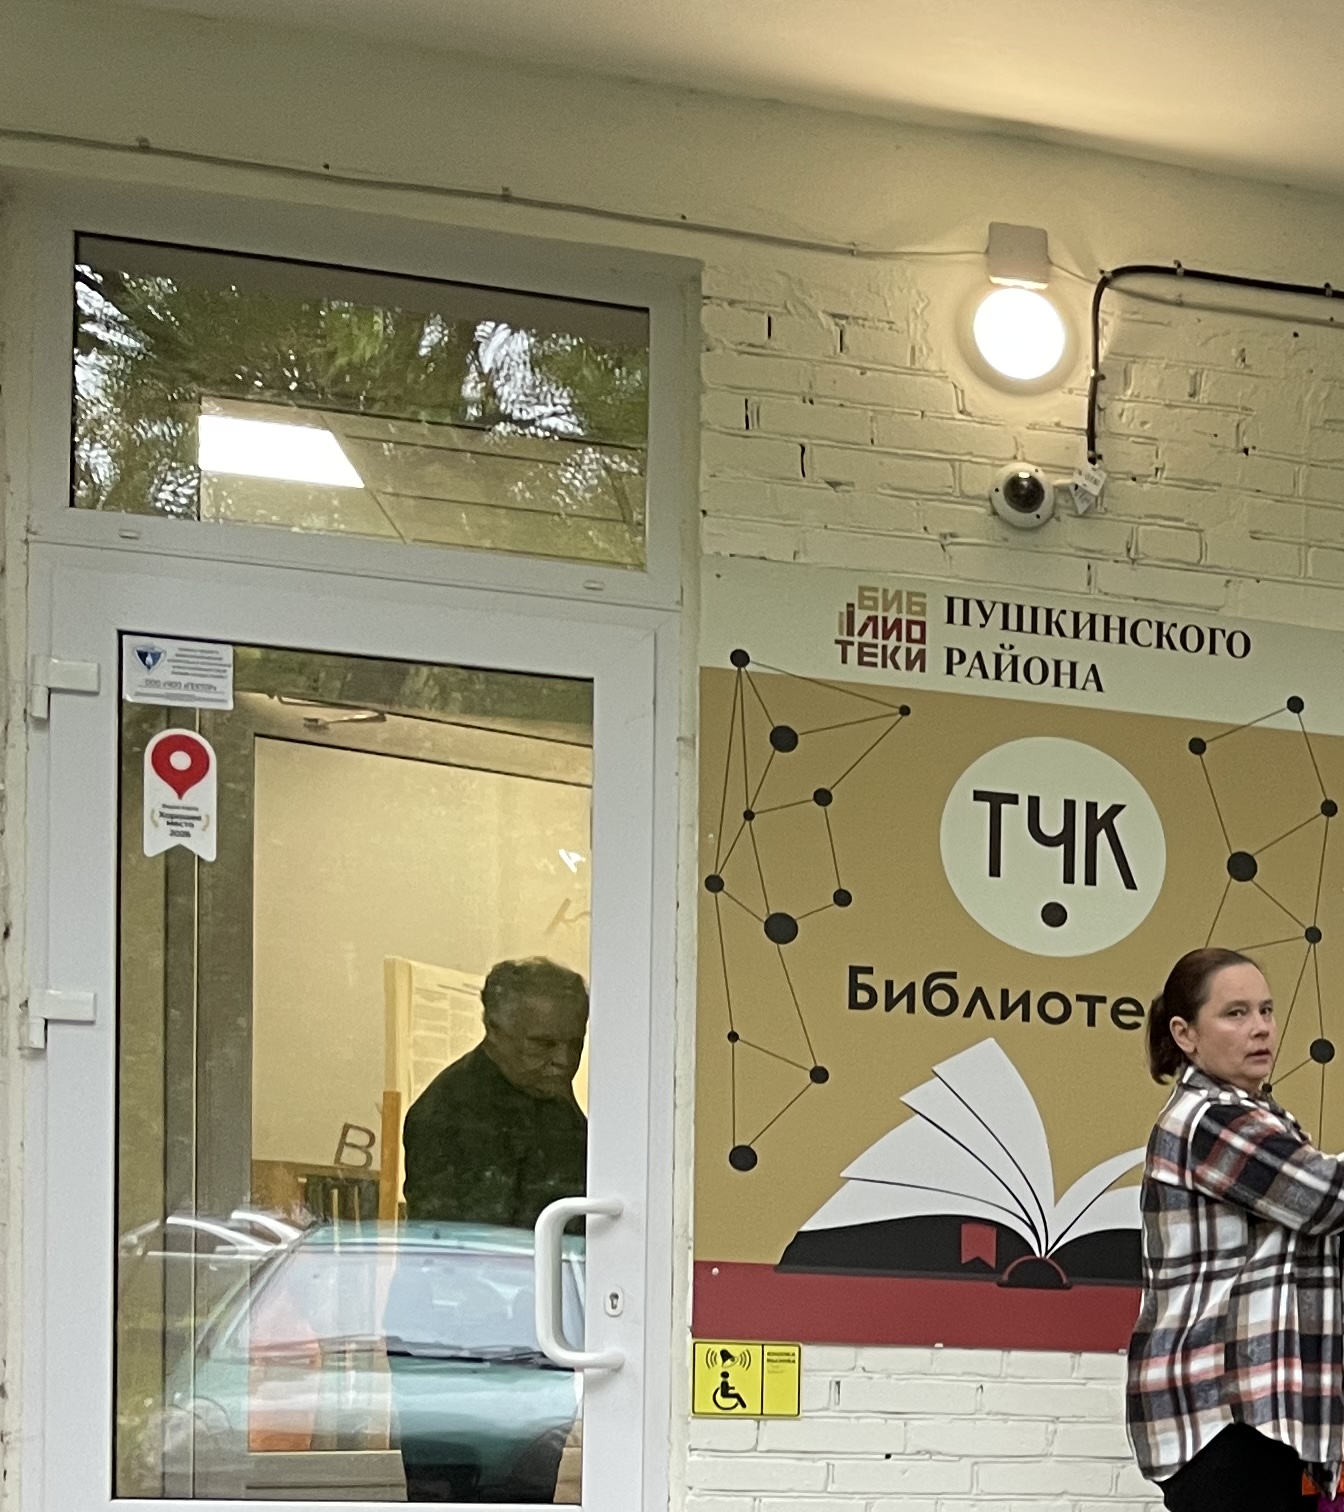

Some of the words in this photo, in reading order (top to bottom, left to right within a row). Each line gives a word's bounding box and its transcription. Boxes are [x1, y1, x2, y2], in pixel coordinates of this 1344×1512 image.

[858, 585, 927, 617] БИБ
[943, 595, 1252, 659] ПУШКИНСКОГО
[834, 638, 927, 673] ТЕКИ
[943, 643, 1104, 693] РАЙОНА
[972, 789, 1138, 891] ТЧК
[848, 965, 1146, 1030] Библиоте
